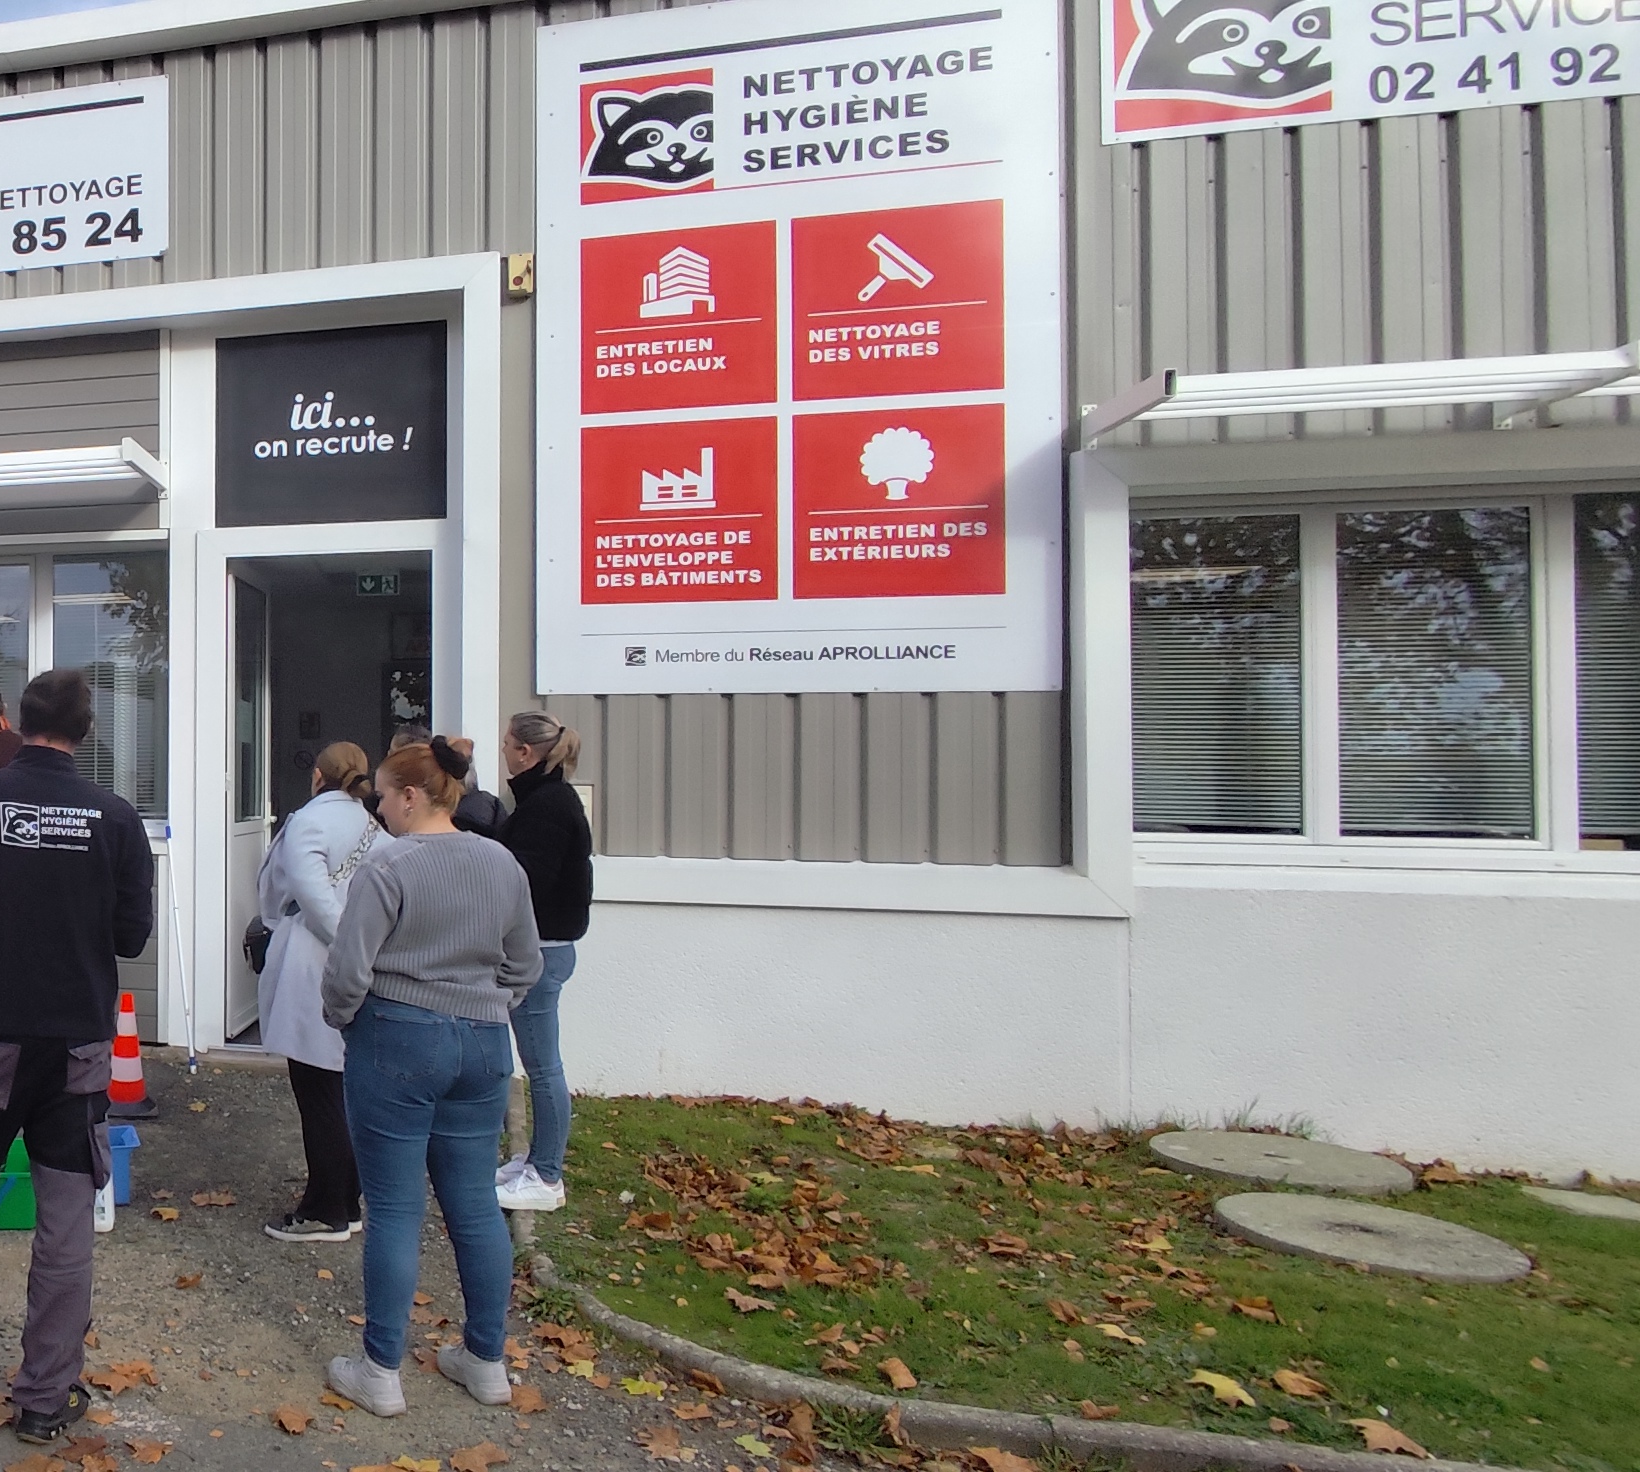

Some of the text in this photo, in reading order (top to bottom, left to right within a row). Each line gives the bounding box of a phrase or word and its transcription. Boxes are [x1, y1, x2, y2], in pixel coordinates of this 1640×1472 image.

[743, 46, 994, 99] NETTOYAGE
[1369, 43, 1621, 103] 02 41 92
[743, 92, 928, 136] HYGIÈNE
[742, 129, 950, 174] SERVICES
[12, 217, 68, 255] 85
[85, 207, 144, 248] 24
[808, 320, 941, 344] NETTOYAGE
[596, 337, 714, 360] ENTRETIEN
[809, 341, 940, 364] DES VITRES
[596, 355, 727, 378] DES LOCAUX
[254, 439, 288, 459] on
[296, 429, 395, 457] recrute
[596, 530, 751, 550] NETTOYAGE DE
[809, 521, 988, 543] ENTRETIEN DES
[809, 543, 952, 562] EXTÉRIEURS
[596, 567, 762, 588] DES BÂTIMENTS
[655, 644, 957, 663] Membre du Réseau APROLLIANCE
[41, 806, 102, 819] NETTOYAGE
[41, 827, 92, 838] SERVICES
